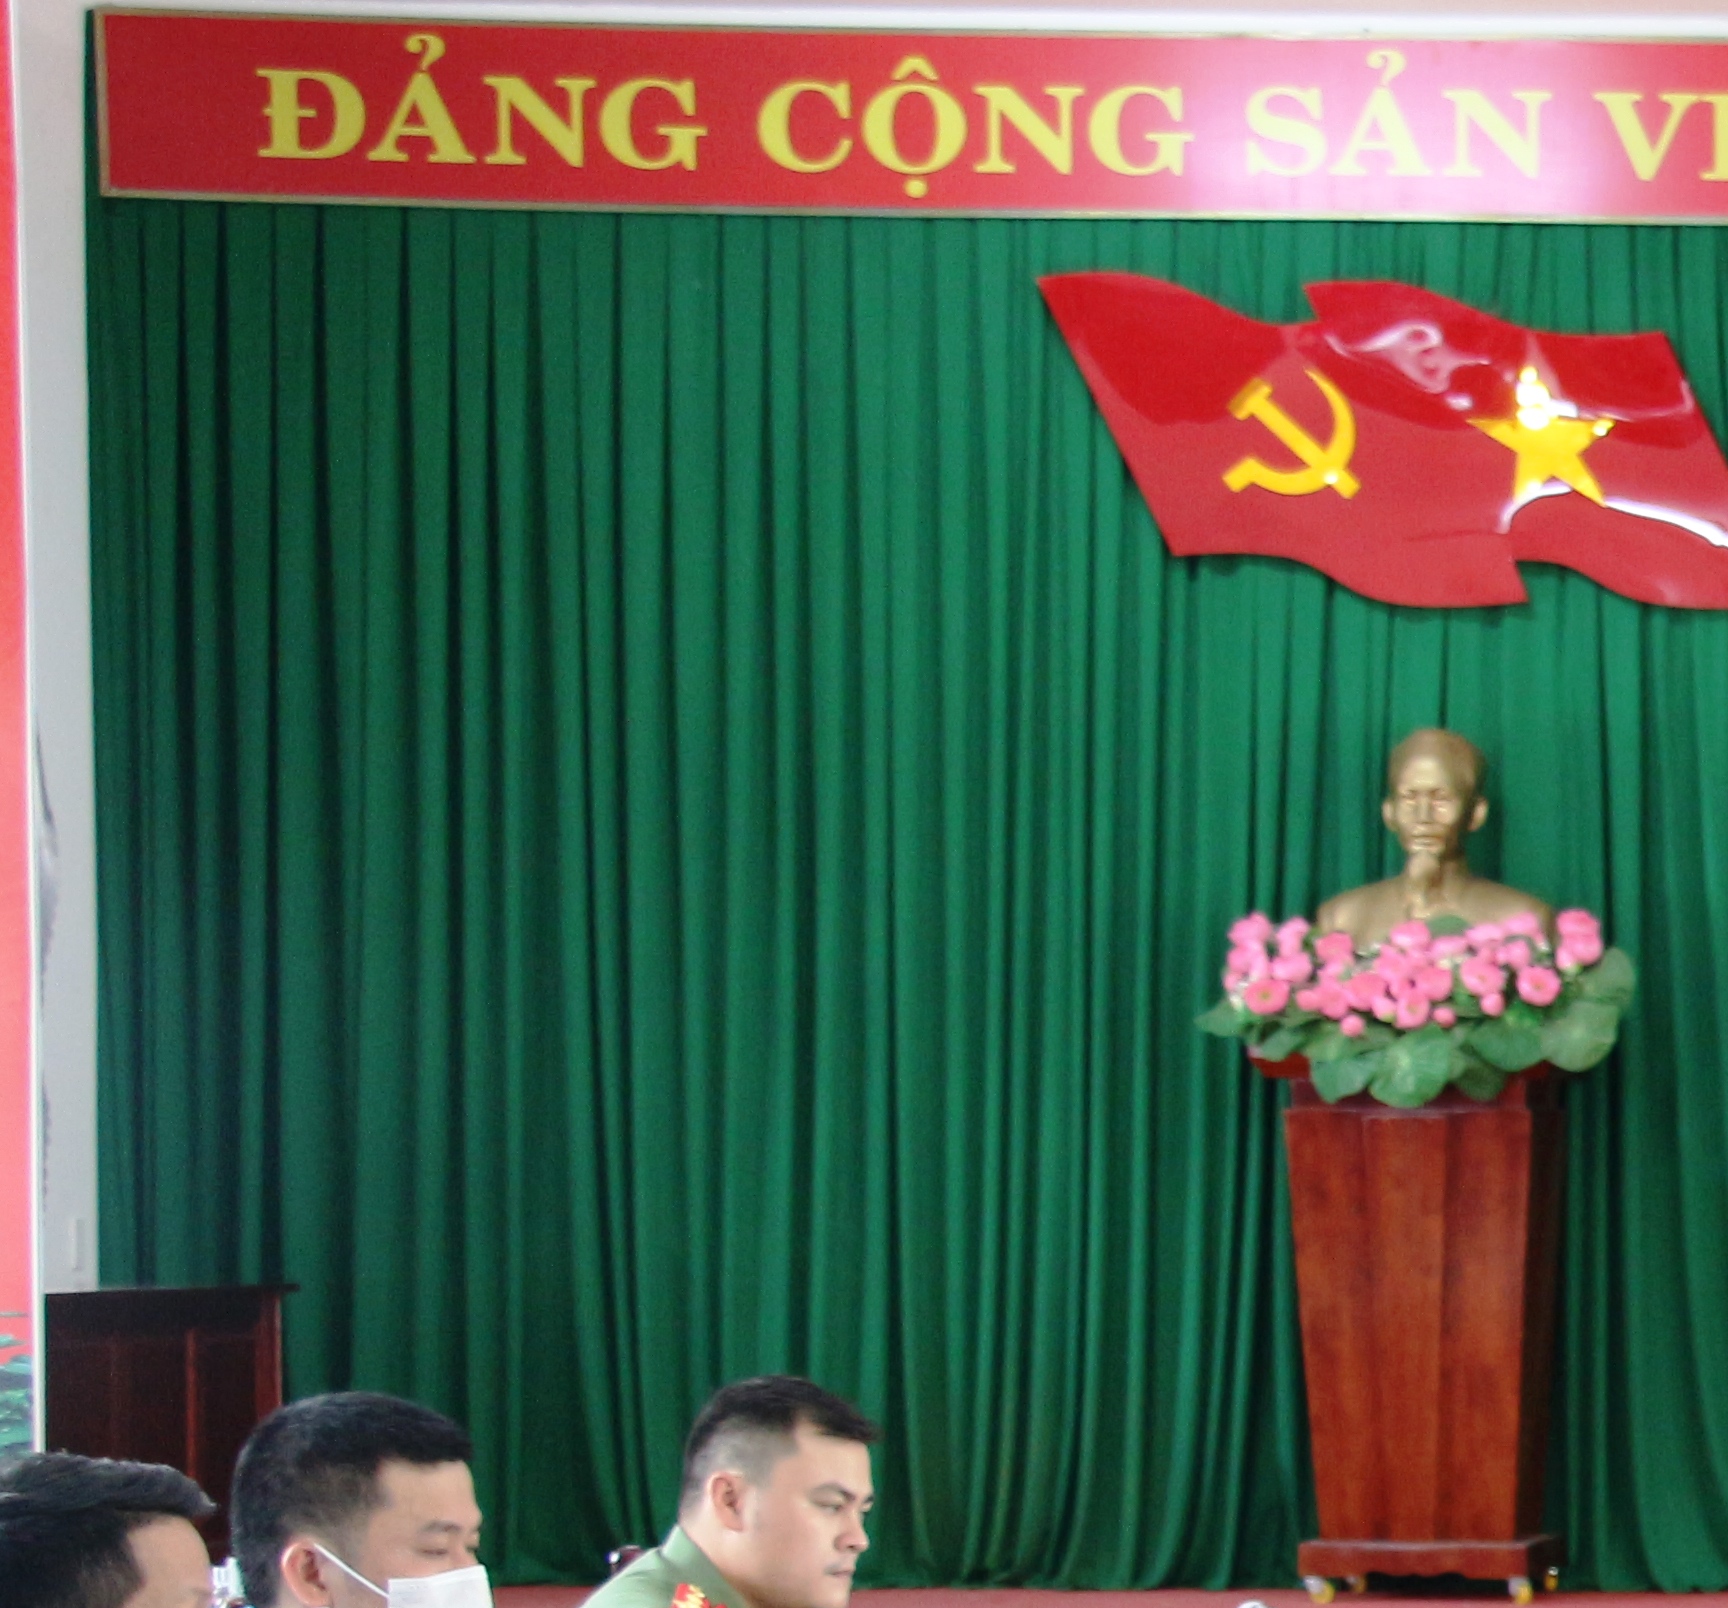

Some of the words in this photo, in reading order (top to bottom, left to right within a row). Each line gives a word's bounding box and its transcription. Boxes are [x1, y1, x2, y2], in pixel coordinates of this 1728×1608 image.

[256, 34, 708, 171] ĐẢNG
[757, 55, 1195, 199] CỘNG
[1245, 50, 1553, 181] SẢN
